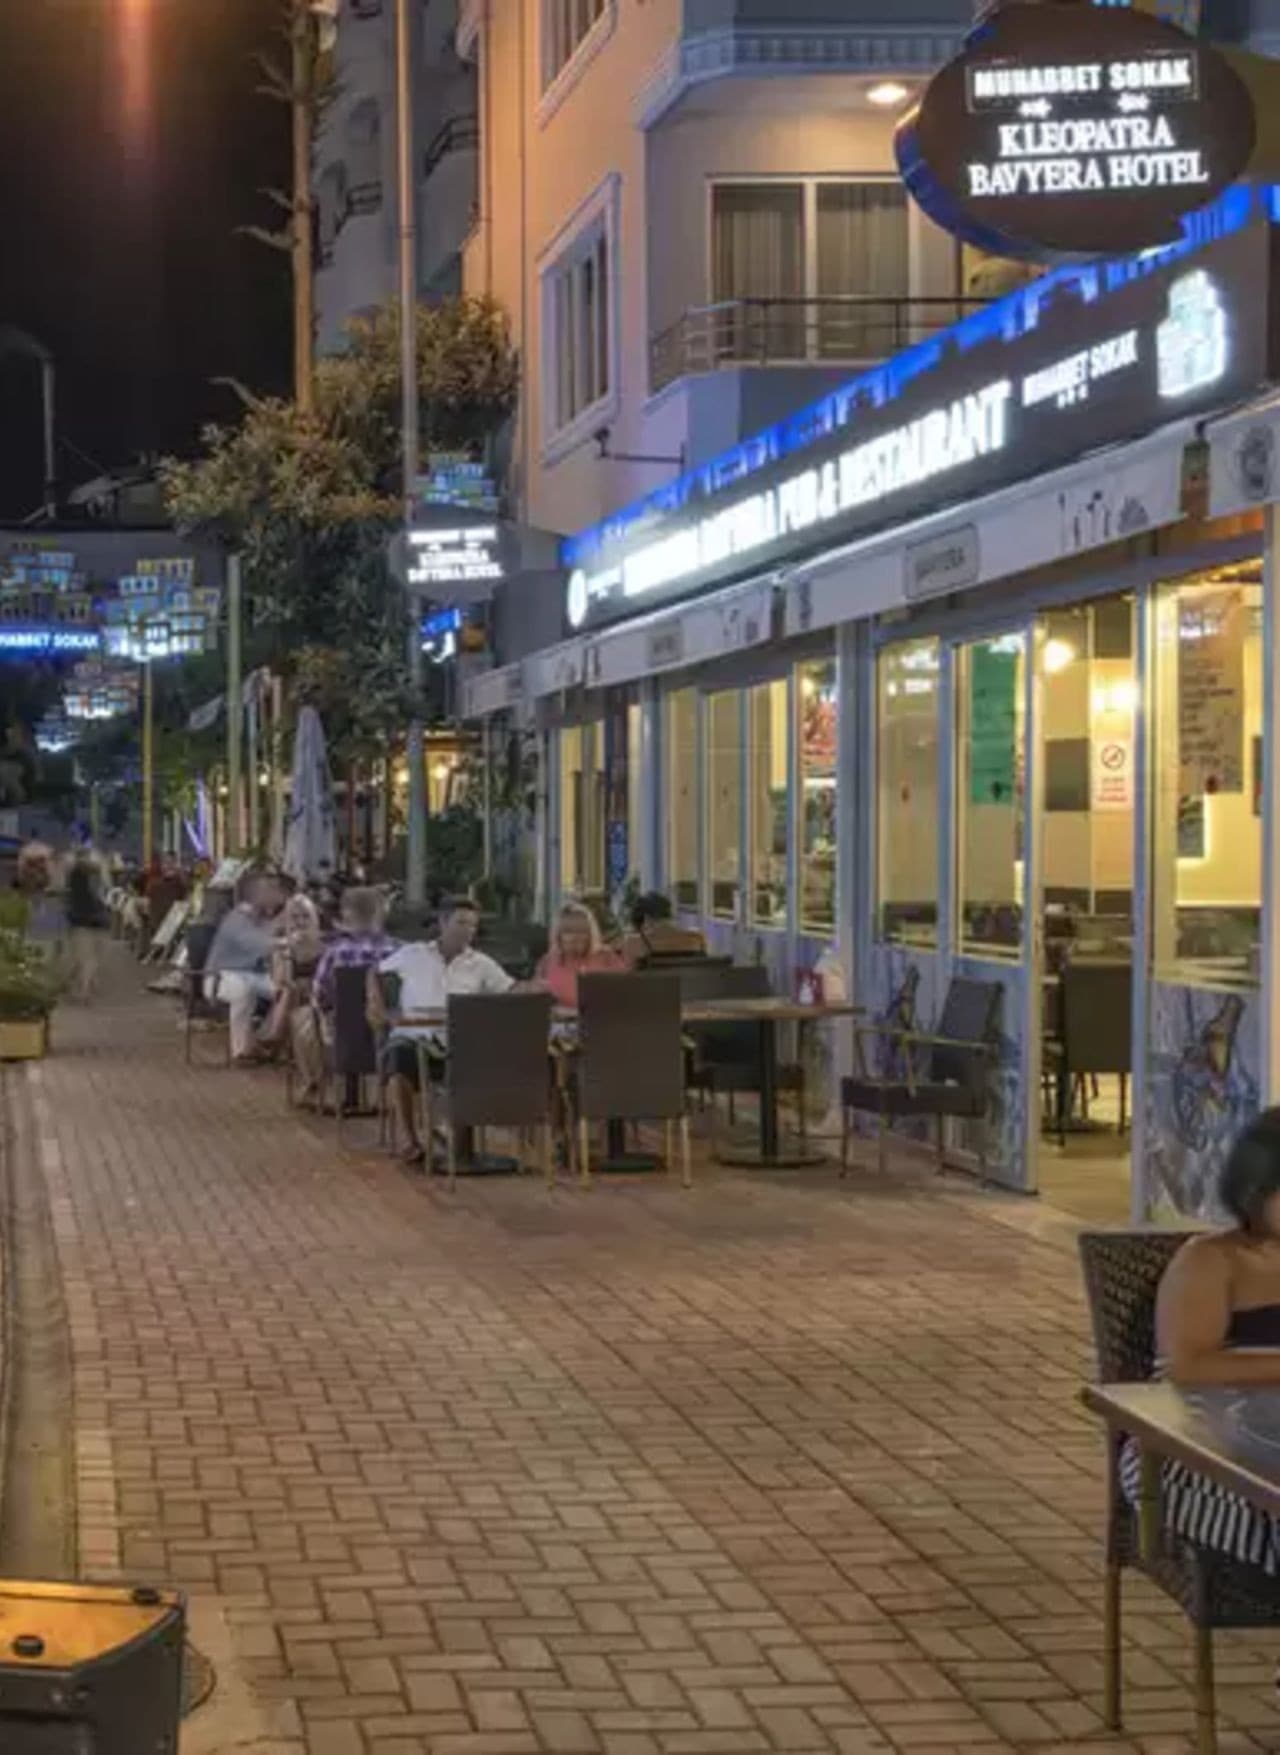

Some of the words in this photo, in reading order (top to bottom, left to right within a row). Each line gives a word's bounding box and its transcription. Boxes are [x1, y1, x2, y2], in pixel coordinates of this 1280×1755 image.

[1108, 58, 1191, 90] SOKAK
[998, 114, 1176, 157] KLEOPATRA
[967, 157, 1105, 197] BAVYERA
[1108, 150, 1209, 188] HOTEL
[838, 378, 1012, 513] RESTAURANT
